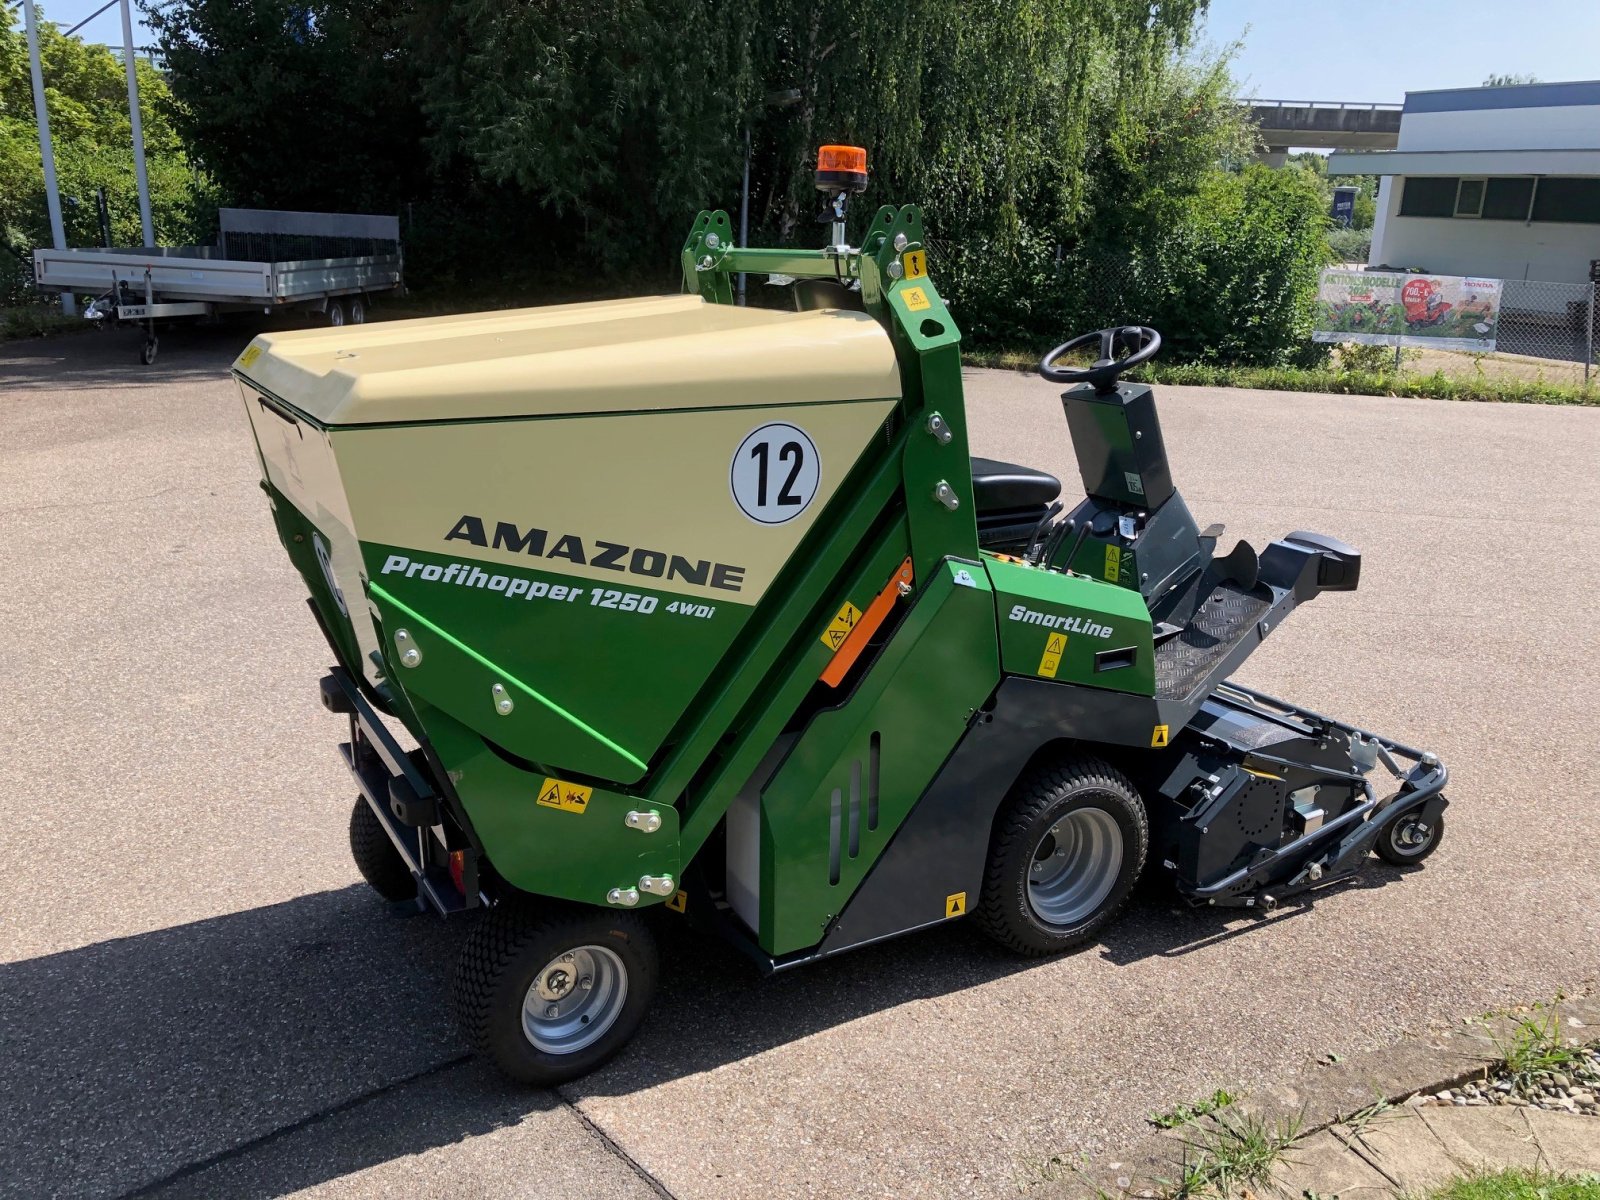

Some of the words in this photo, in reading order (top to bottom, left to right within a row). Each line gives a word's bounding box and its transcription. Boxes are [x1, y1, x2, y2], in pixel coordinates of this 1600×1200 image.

[1464, 281, 1494, 289] HONDA
[751, 441, 803, 506] 12
[444, 515, 745, 592] AMAZONE
[381, 554, 583, 603] Profihopper
[590, 588, 659, 615] 1250
[665, 601, 716, 619] 4WDi
[1009, 604, 1114, 638] SmartLine
